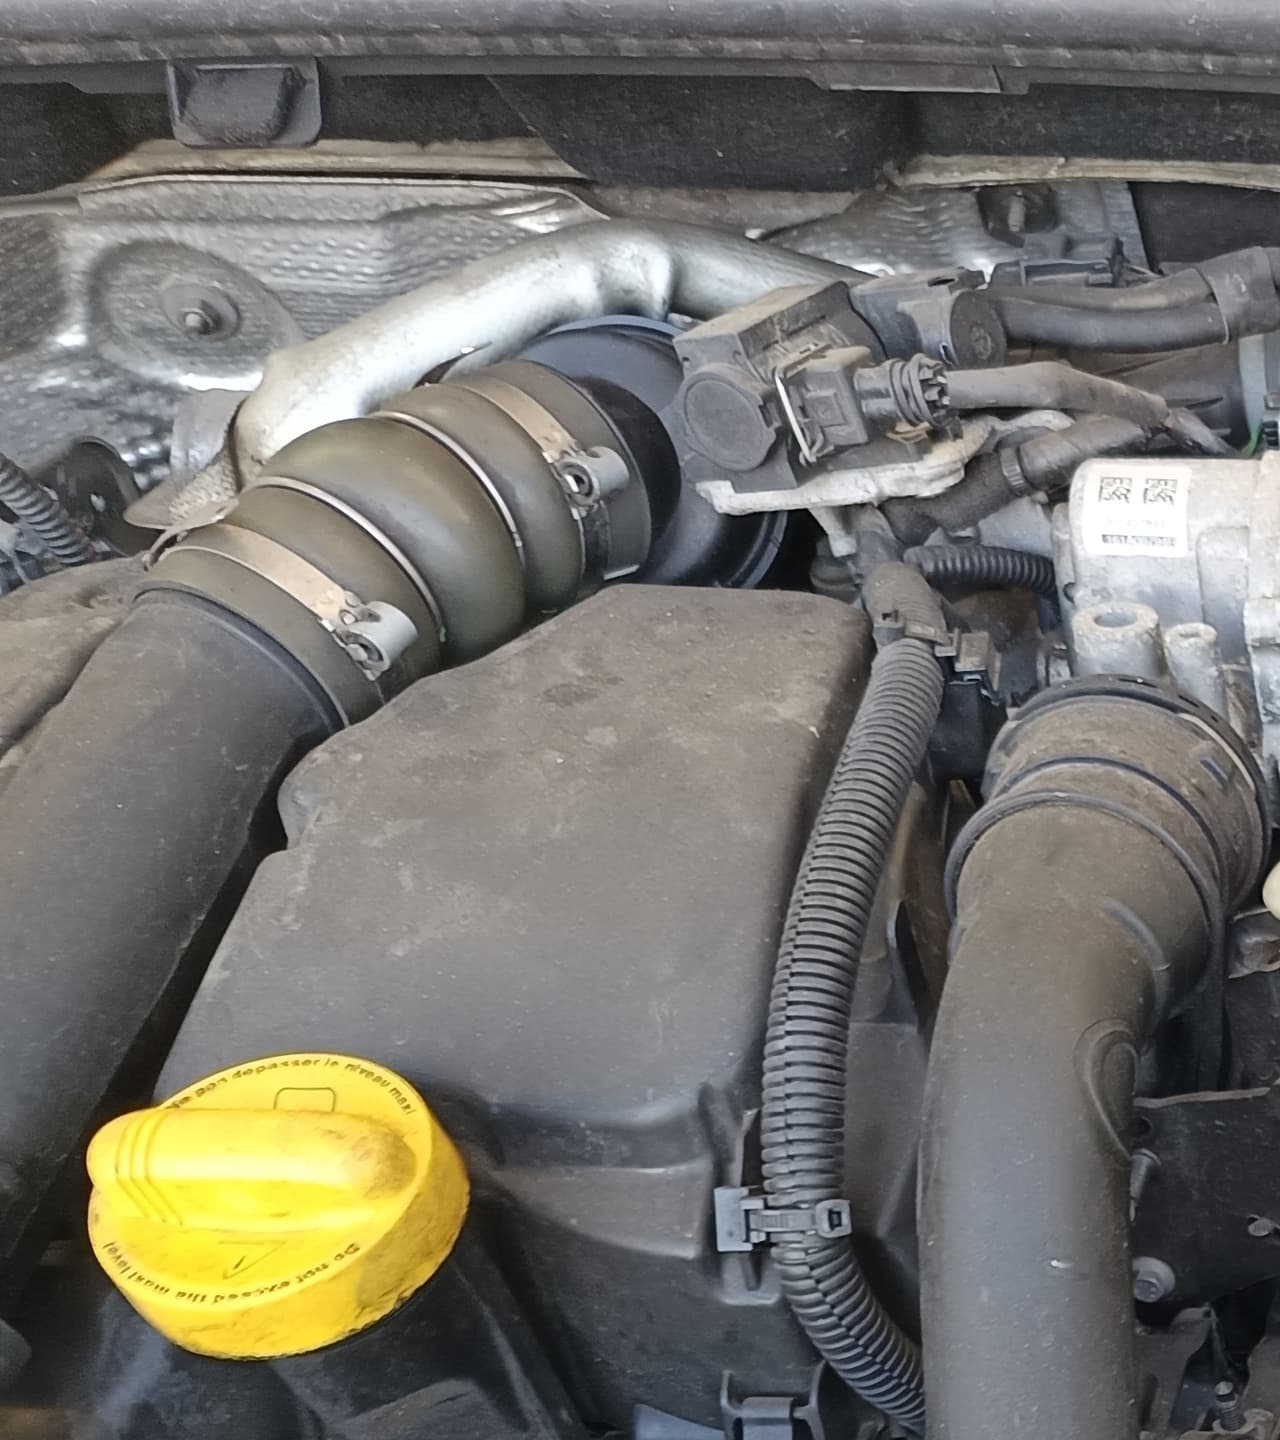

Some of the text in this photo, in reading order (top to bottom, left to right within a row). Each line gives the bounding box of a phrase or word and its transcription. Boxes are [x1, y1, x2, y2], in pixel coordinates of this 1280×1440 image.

[344, 1061, 391, 1091] niveau
[388, 1085, 416, 1116] maxi
[102, 1241, 132, 1276] level
[334, 1241, 362, 1262] Do
[129, 1272, 170, 1296] maxi
[212, 1280, 291, 1306] exceed
[176, 1291, 208, 1305] the
